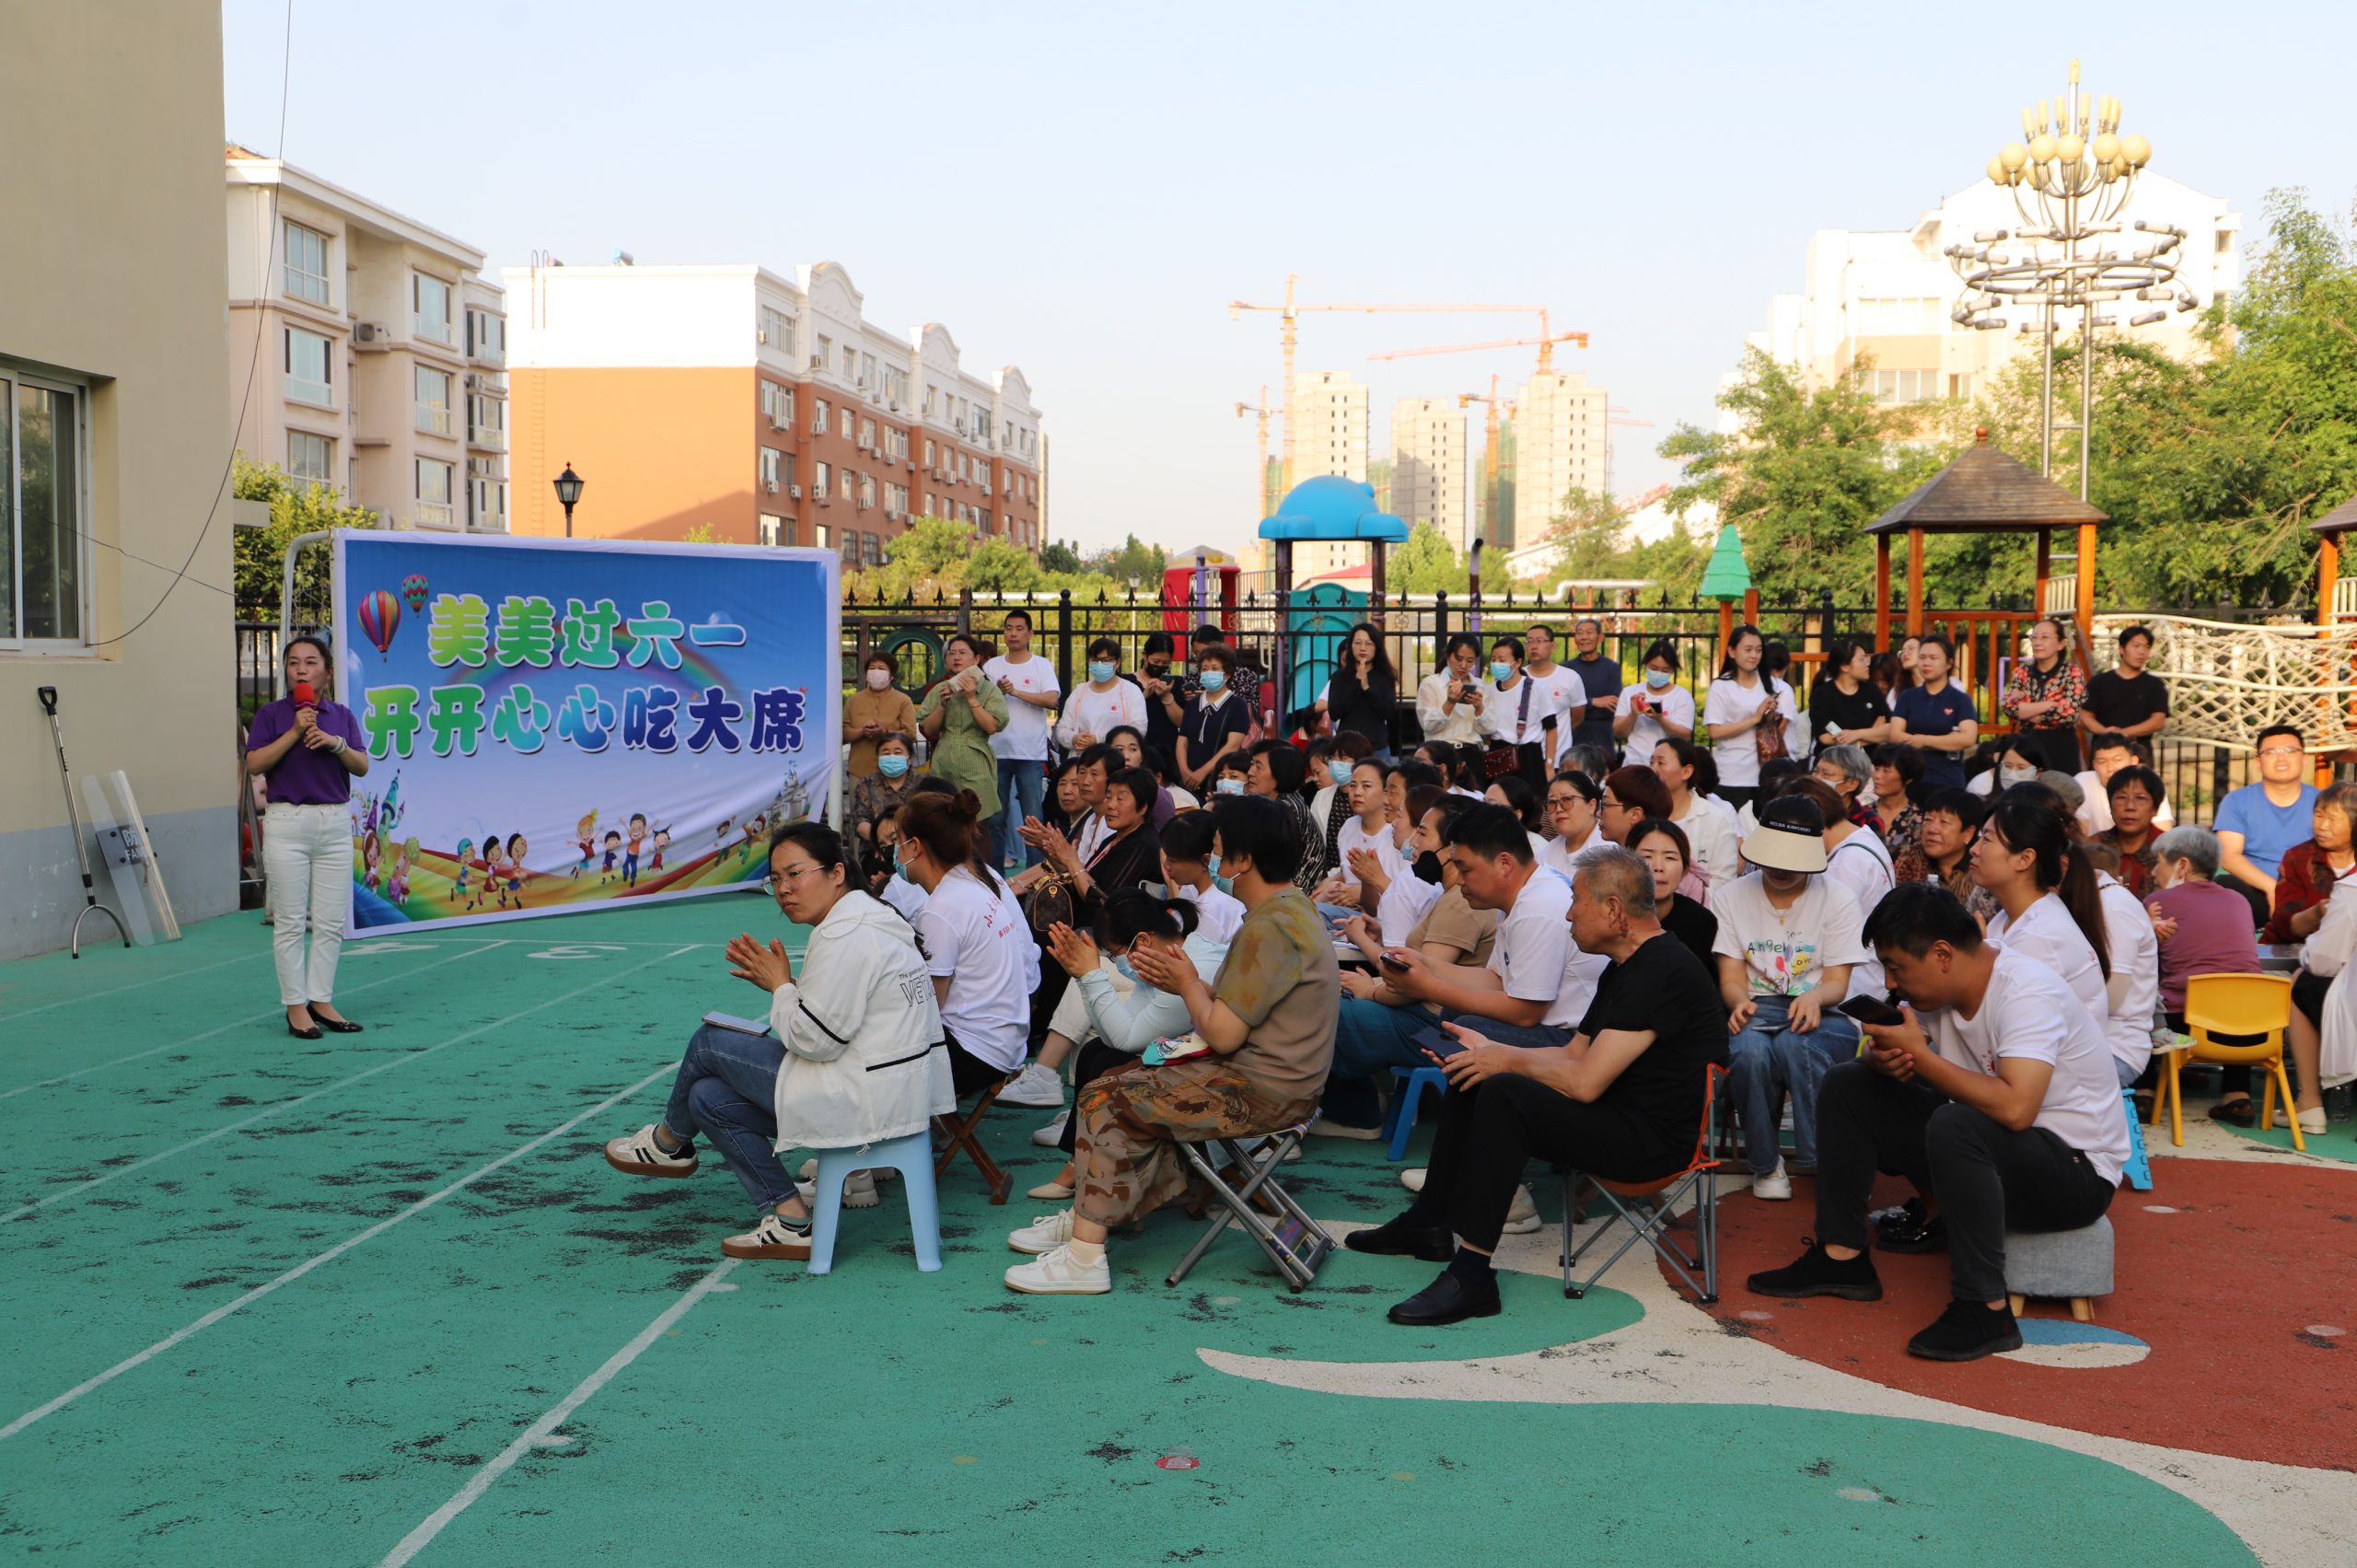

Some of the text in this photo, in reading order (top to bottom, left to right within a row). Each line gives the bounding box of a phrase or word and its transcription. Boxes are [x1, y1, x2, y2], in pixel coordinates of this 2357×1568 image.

[427, 594, 747, 669] 美美过六一
[364, 684, 806, 760] 开开心心吃大席
